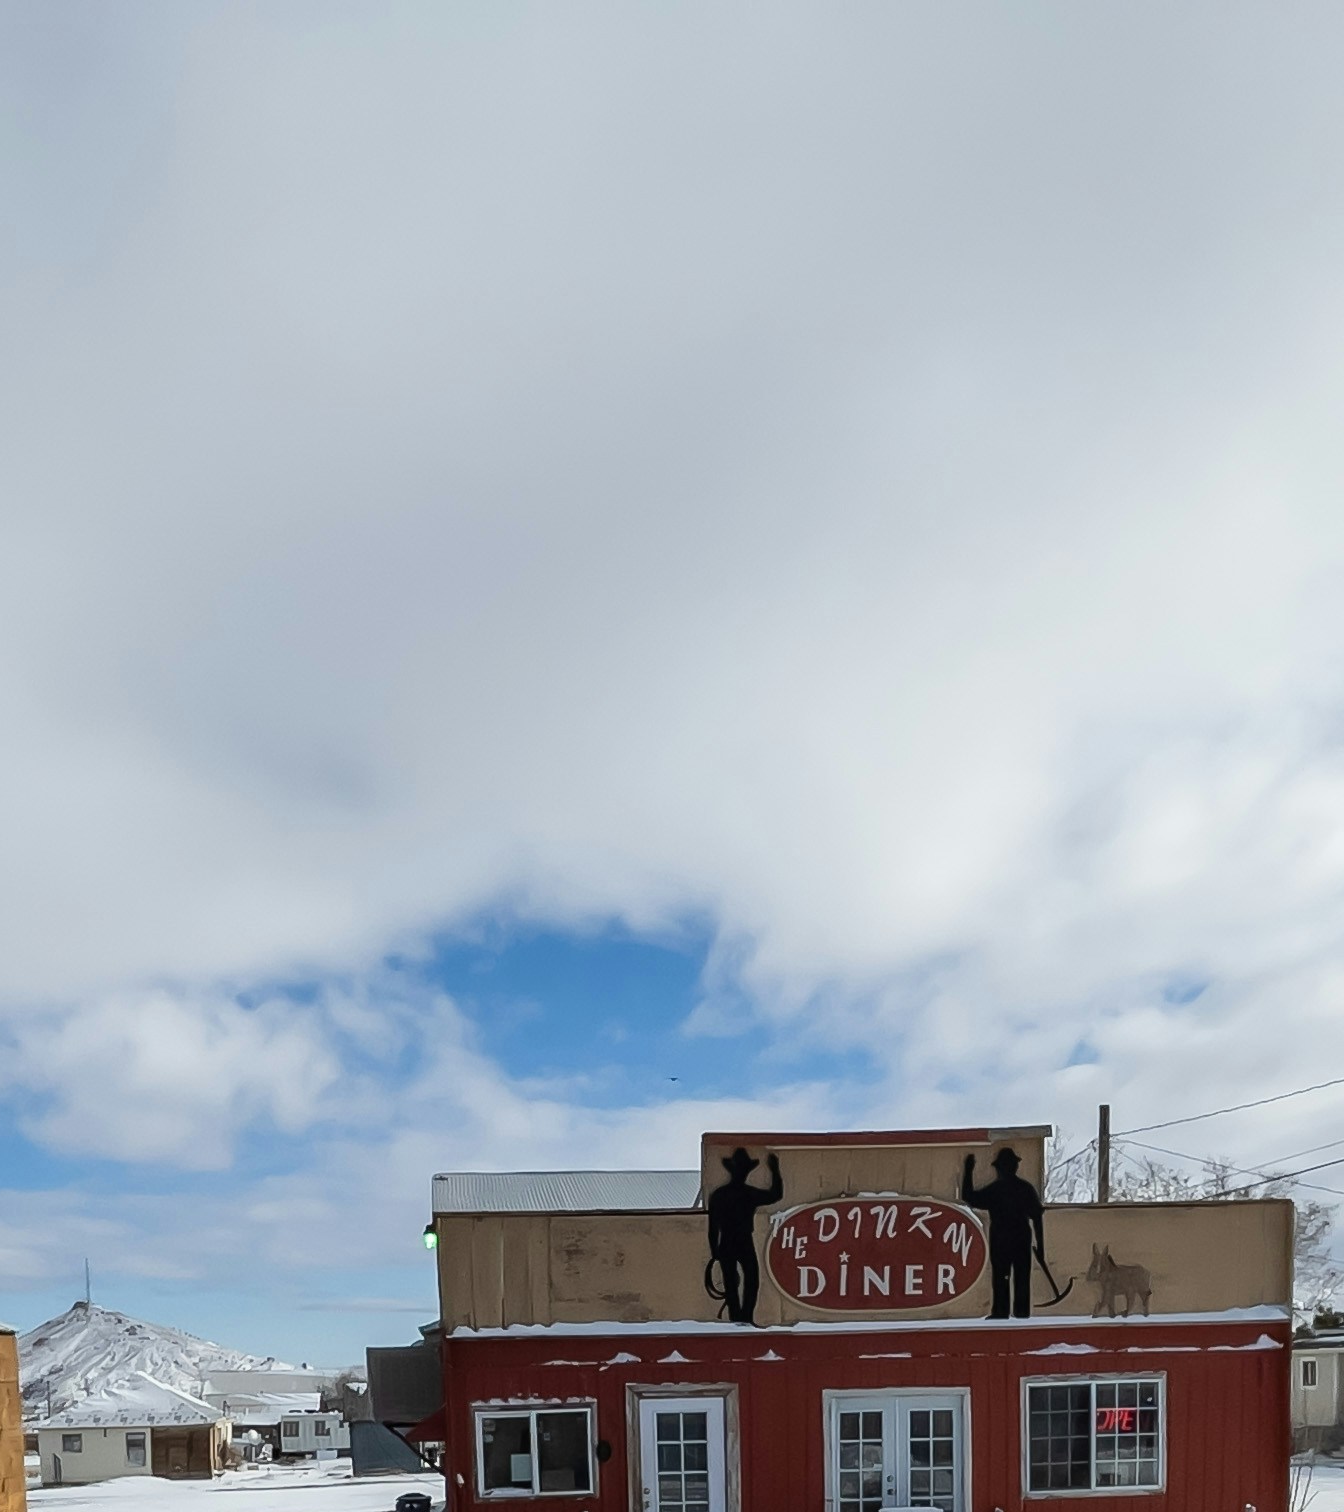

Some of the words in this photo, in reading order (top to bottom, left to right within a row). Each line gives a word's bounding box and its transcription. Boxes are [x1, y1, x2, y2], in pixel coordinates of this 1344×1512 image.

[769, 1213, 808, 1260] THE
[813, 1205, 974, 1267] DINKY
[797, 1254, 956, 1298] DINER
